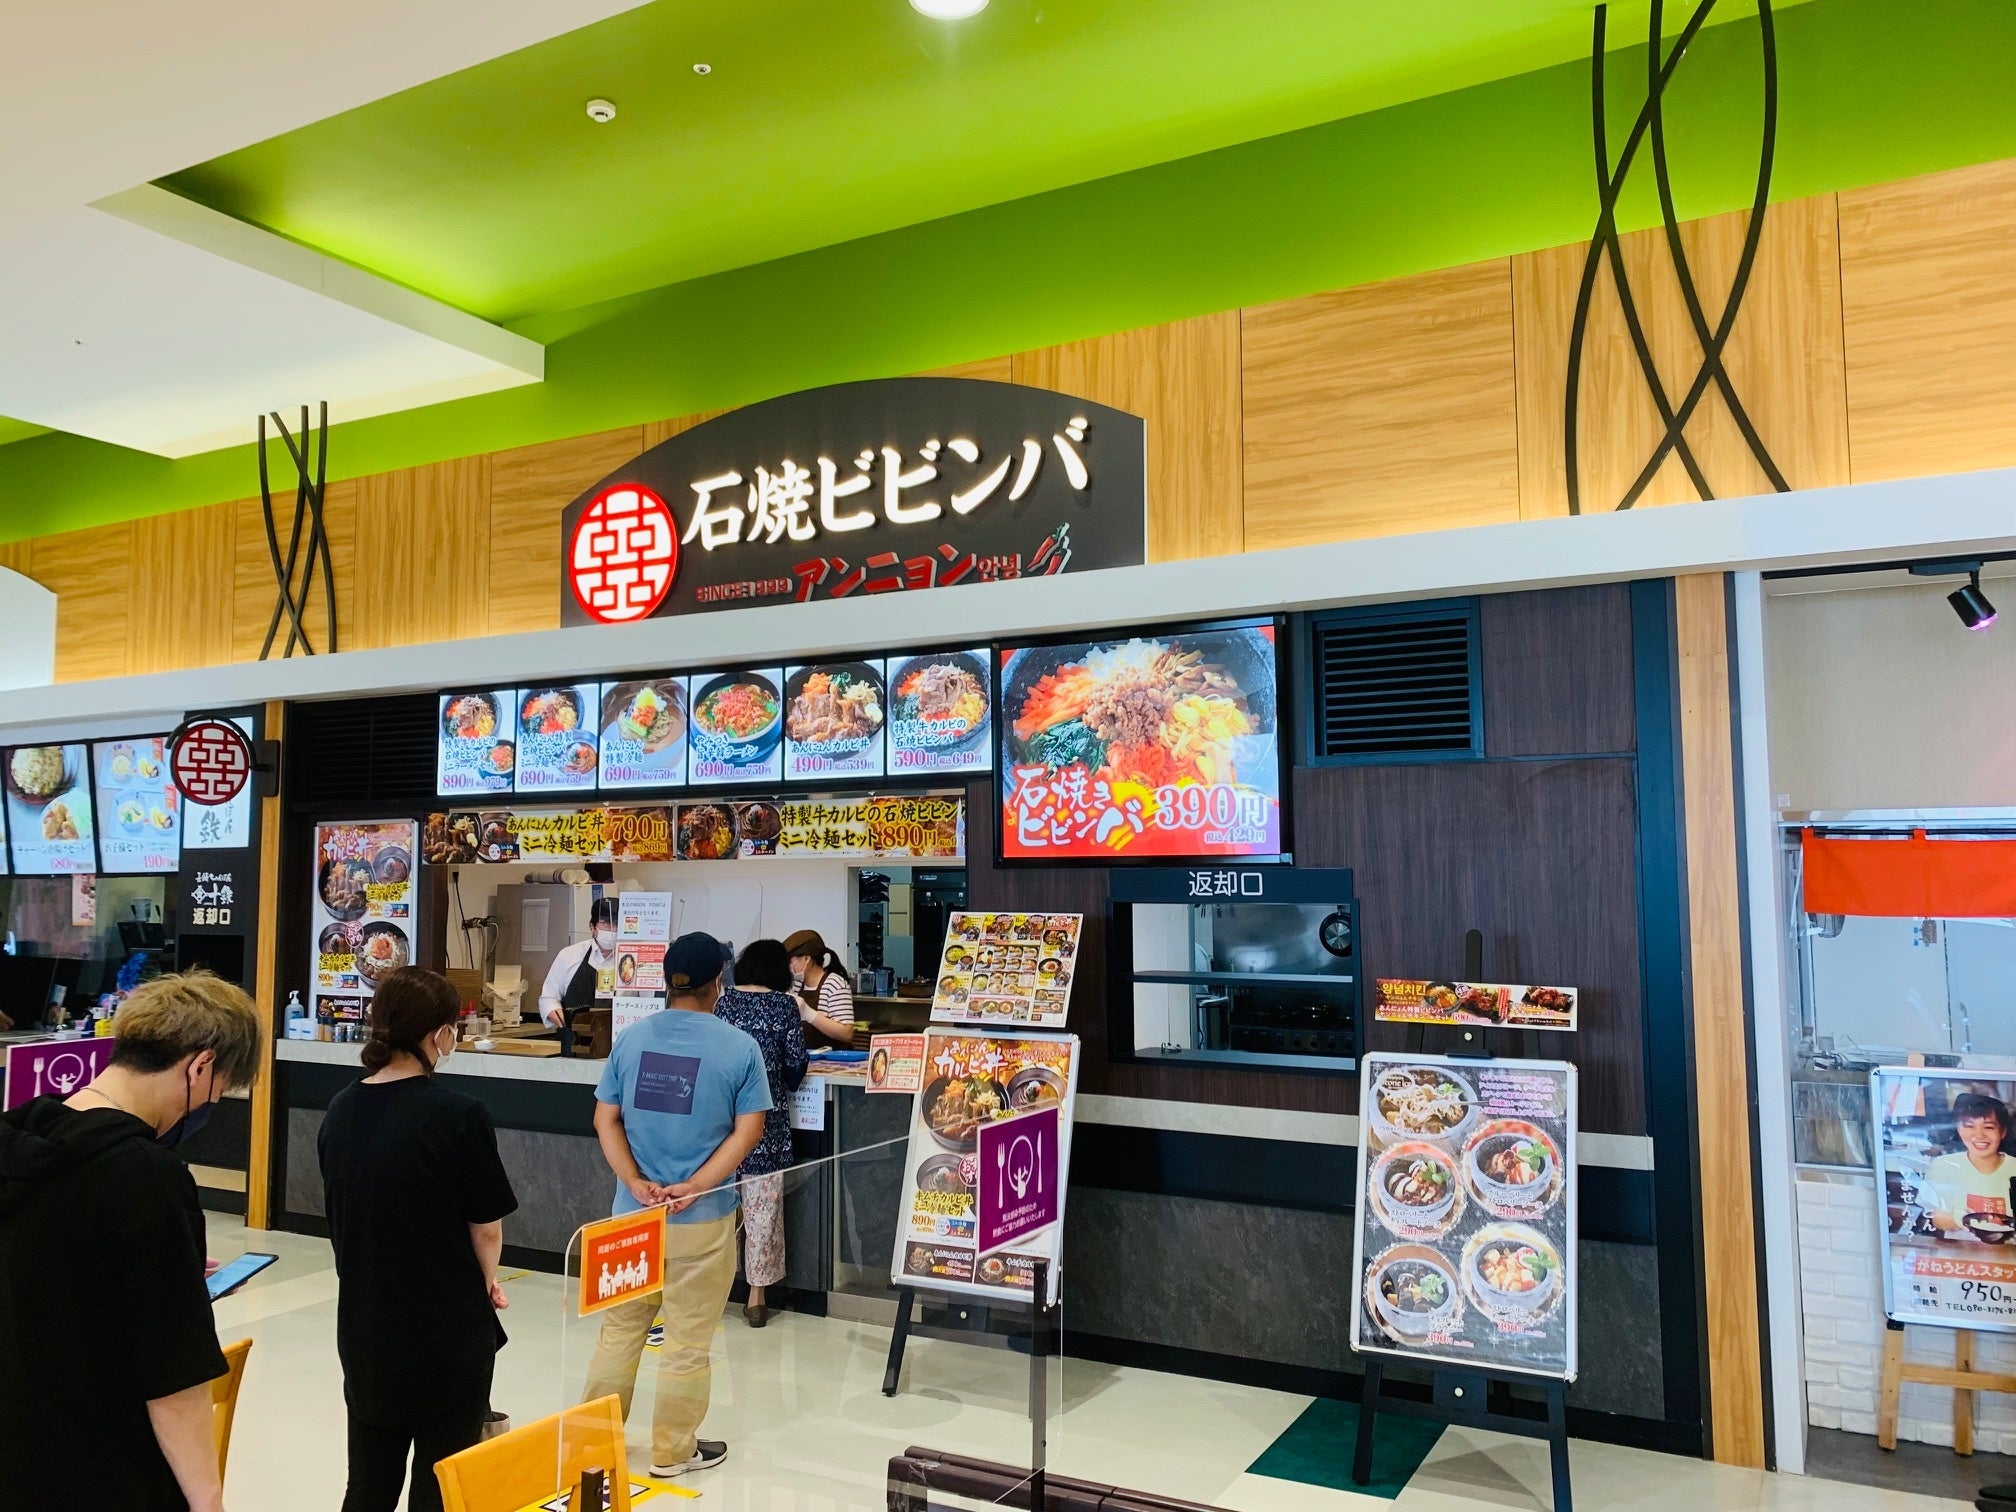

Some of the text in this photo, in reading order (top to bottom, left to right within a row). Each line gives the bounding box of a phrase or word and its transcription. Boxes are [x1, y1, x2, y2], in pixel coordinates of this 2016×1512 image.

[681, 417, 1090, 551] 石焼ビビンバ
[792, 543, 977, 602] アンニョン
[977, 552, 1022, 582] 안녕
[695, 576, 792, 602] SINCE 1999
[893, 719, 967, 734] 特製牛カルビの
[791, 738, 870, 754] あんにょんカルビ丼
[791, 755, 833, 772] 490円
[894, 750, 938, 768] 590円
[520, 770, 554, 786] 690円
[605, 766, 641, 782] 690円
[695, 761, 733, 778] 690円
[443, 774, 474, 789] 890円
[1013, 766, 1113, 810] 石焼き
[1154, 783, 1268, 830] 390円
[507, 814, 605, 833] あんにょんカルビ丼
[610, 813, 668, 841] 790円
[1018, 800, 1144, 848] ビビンバ
[521, 833, 608, 854] ミニ冷麺セット
[779, 827, 877, 849] ミニ冷麺セット
[881, 825, 938, 849] 890円
[1205, 828, 1267, 844] 税込429円
[1188, 871, 1263, 897] 返却口
[193, 908, 231, 925] 返却口
[1382, 983, 1427, 996] 양념치킨
[915, 1190, 973, 1207] キムチカルビ丼
